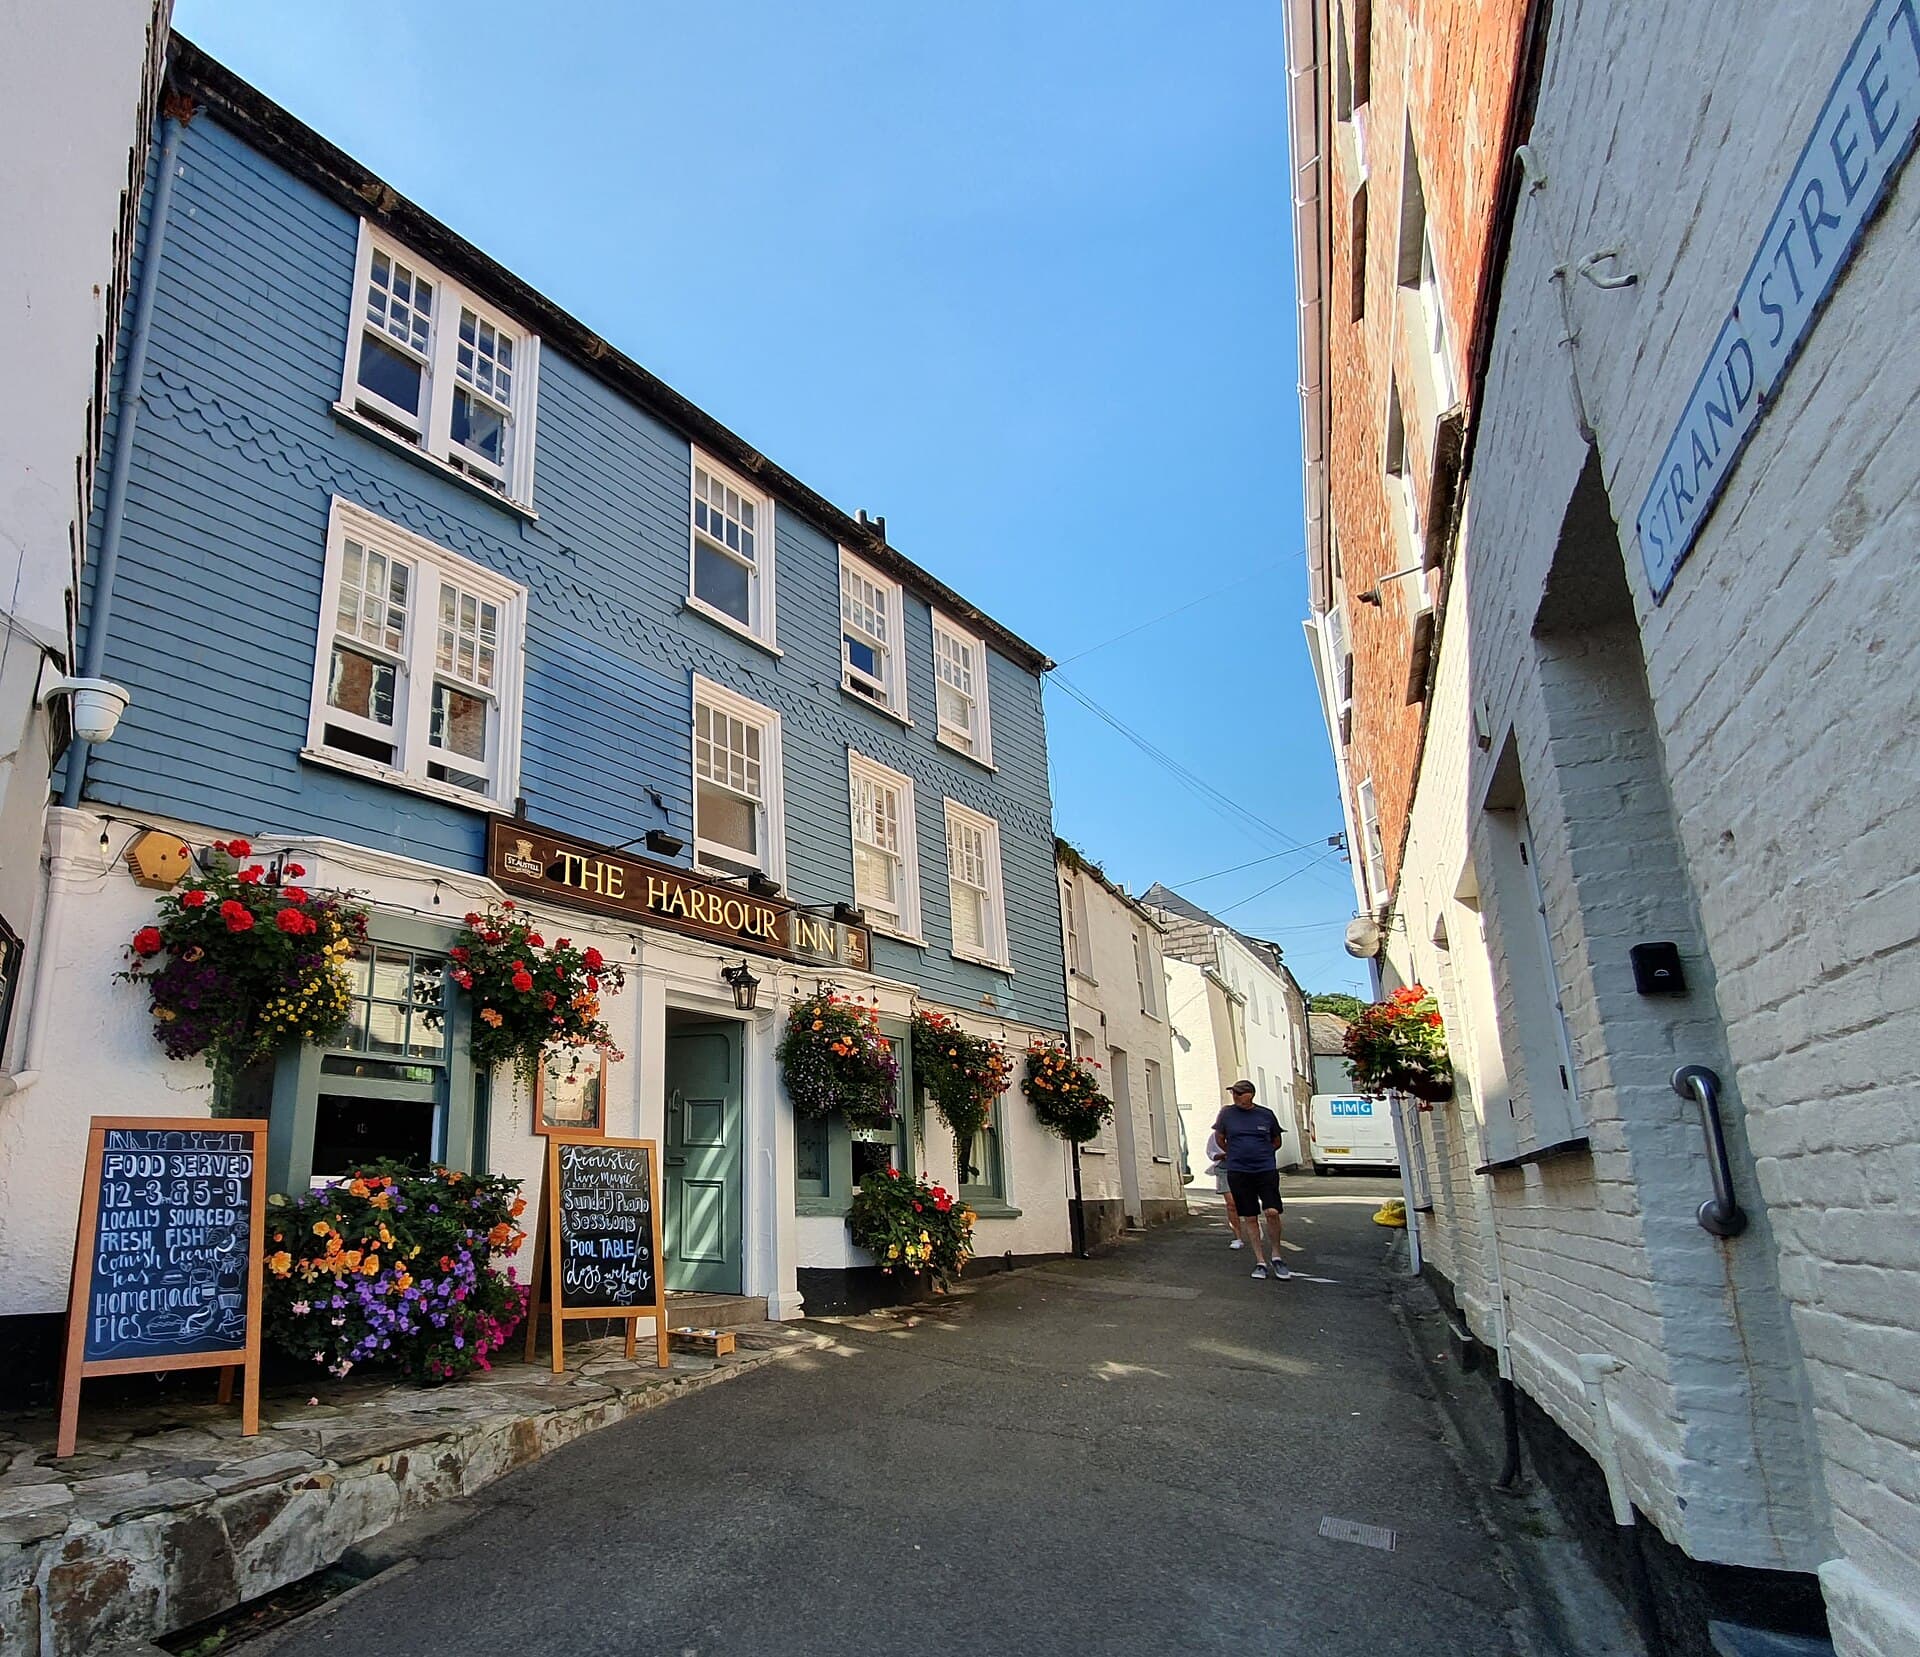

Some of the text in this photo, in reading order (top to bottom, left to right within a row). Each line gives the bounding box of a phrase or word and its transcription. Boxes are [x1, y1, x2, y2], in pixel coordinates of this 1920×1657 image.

[1650, 337, 1755, 568] STRAND
[555, 849, 836, 955] THE HARBOUR INN
[1332, 1103, 1371, 1113] HMG
[104, 1154, 252, 1179] FOOD SERVED
[562, 1148, 640, 1172] Acoustic
[171, 1179, 189, 1206] &
[564, 1188, 649, 1215] Sunday Piano
[101, 1208, 236, 1231] LOCALLY SOURCED
[571, 1210, 637, 1233] Sessions
[100, 1228, 205, 1253] FRESH FISH
[570, 1238, 635, 1259] POOL TABLE
[98, 1245, 221, 1275] Cornish Cream
[107, 1269, 149, 1288] Teas
[566, 1258, 652, 1291] dogs welcome
